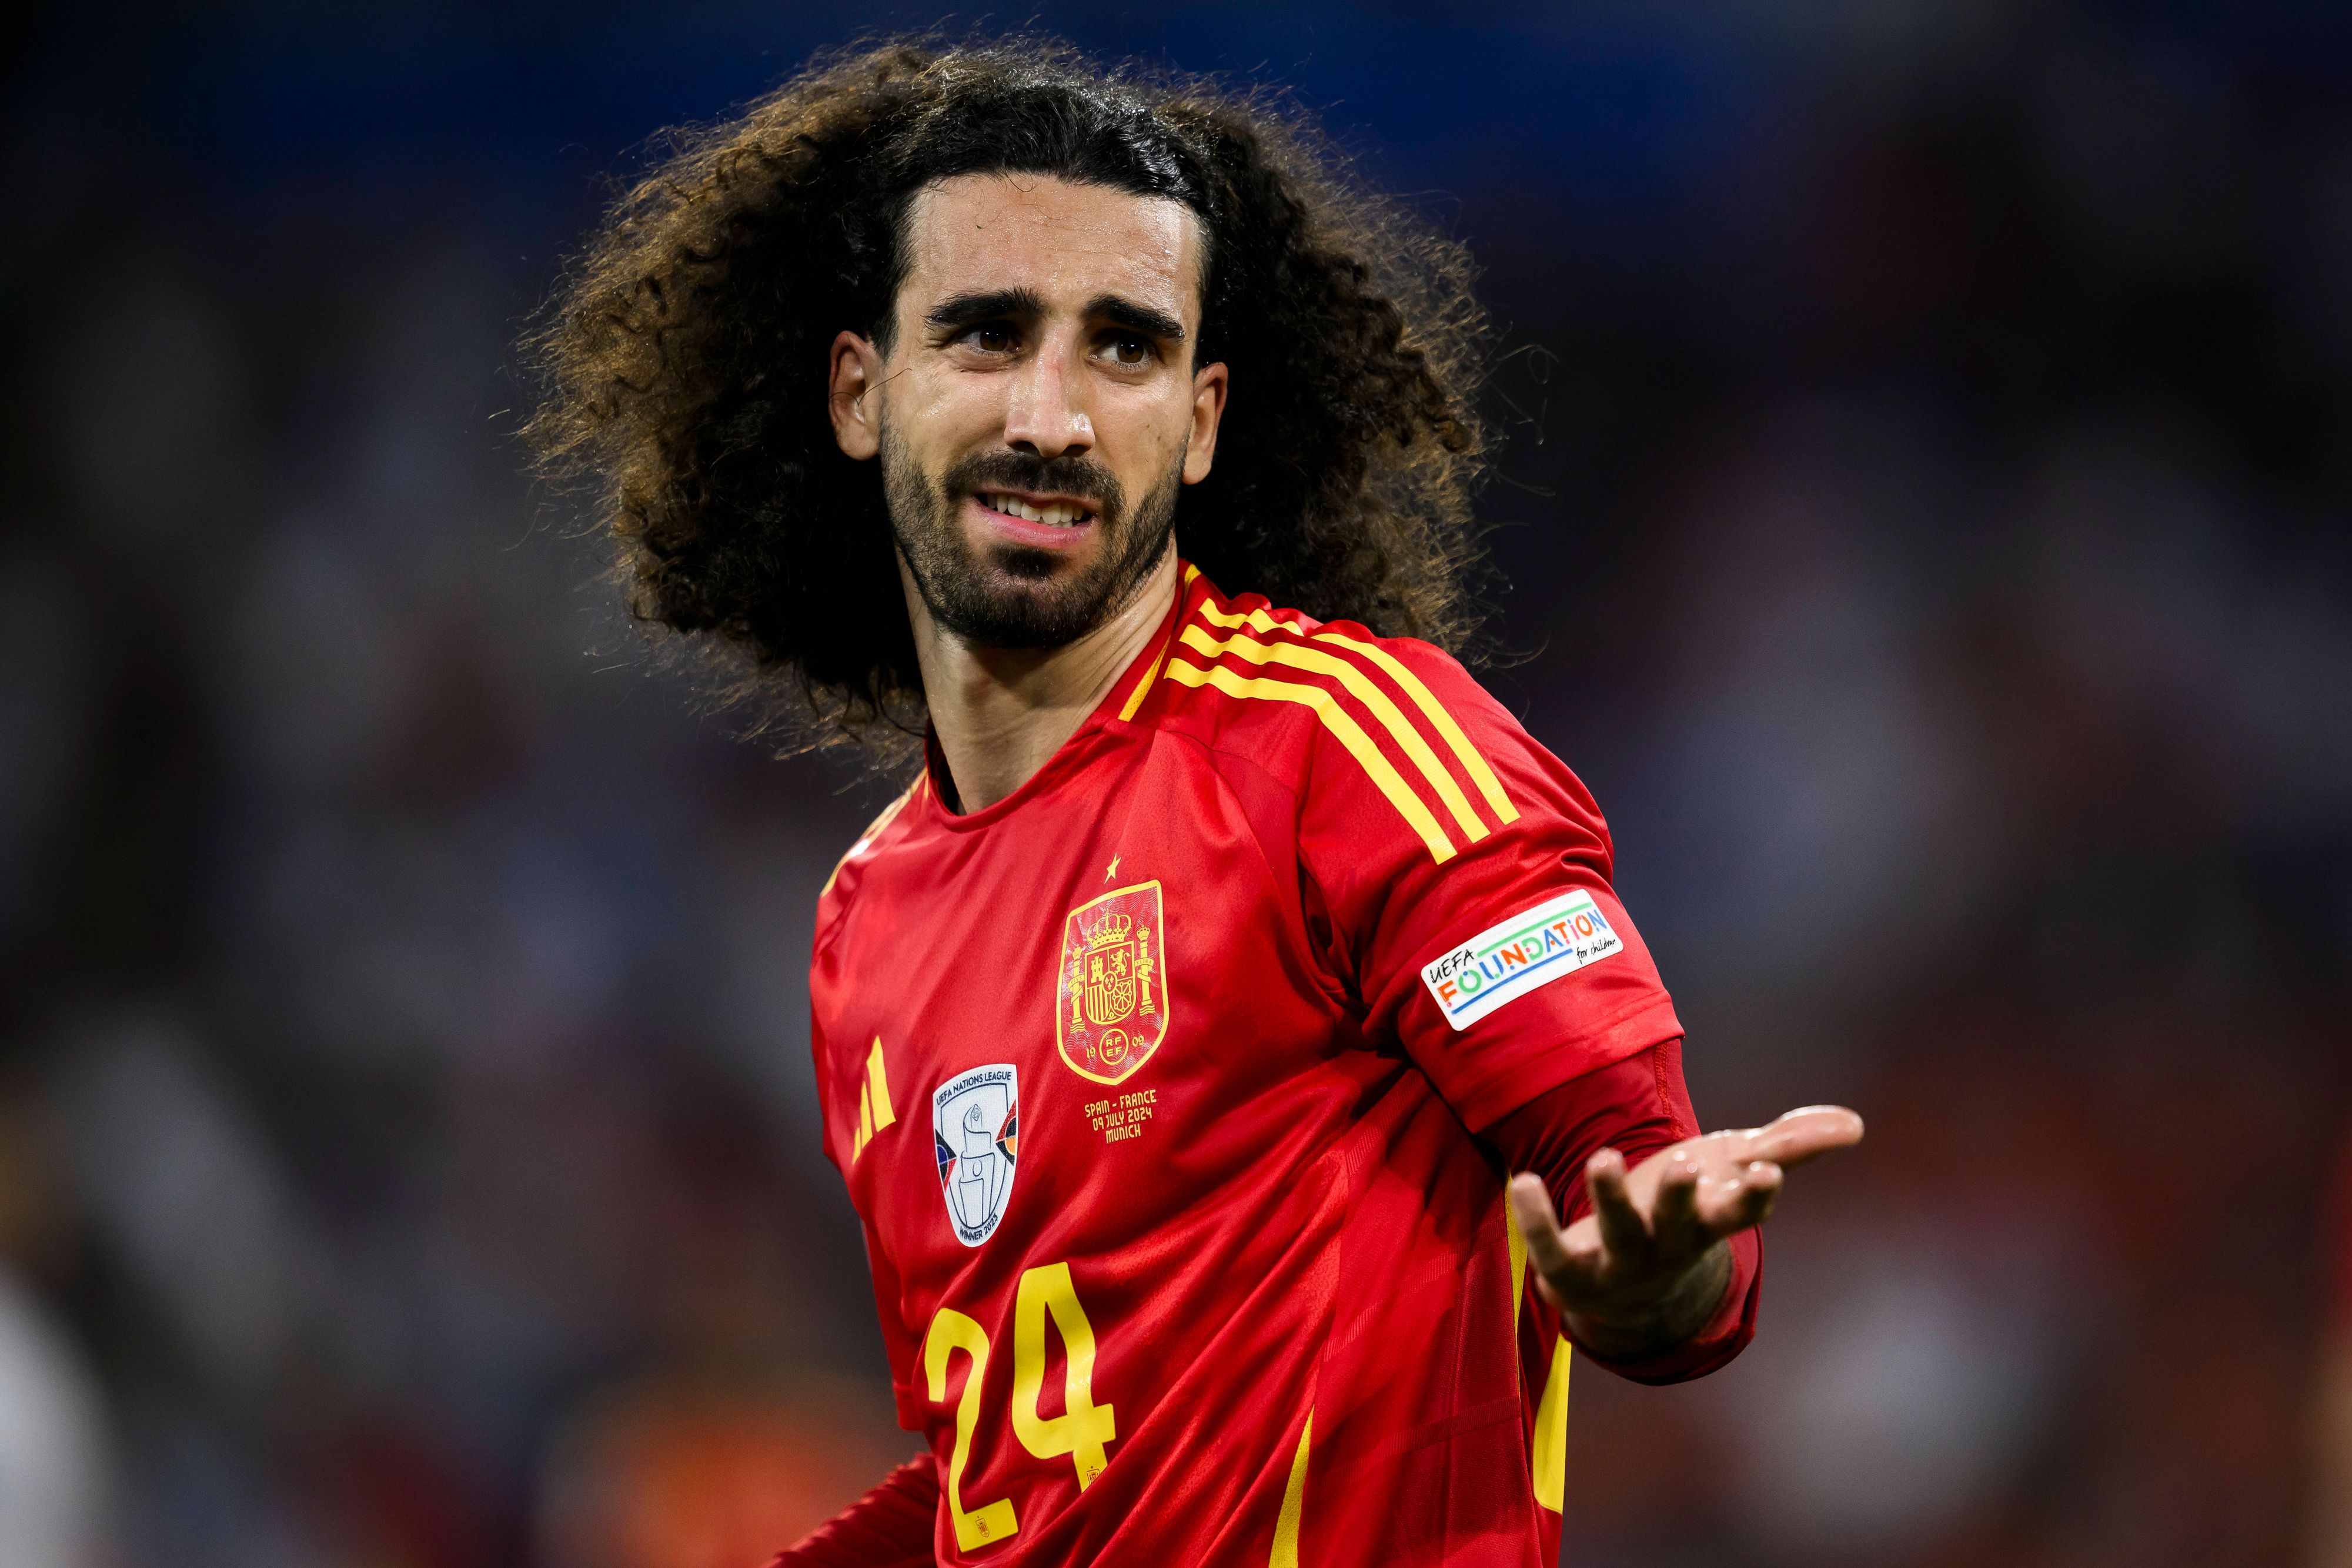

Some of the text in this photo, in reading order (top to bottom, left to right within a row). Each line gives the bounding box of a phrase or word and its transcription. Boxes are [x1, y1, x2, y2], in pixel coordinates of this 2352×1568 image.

[1429, 948, 1474, 984] UEFA
[1437, 908, 1608, 1008] FOUNDATION
[1577, 947, 1587, 965] for
[1086, 1047, 1096, 1058] 19
[1132, 1035, 1144, 1047] 09
[936, 1071, 1012, 1105] UEFA NATIONS LEAGUE
[1084, 1099, 1110, 1118] SPAIN
[1119, 1089, 1157, 1109] FRANCE
[1093, 1106, 1152, 1131] 09 JULY 2024
[1105, 1123, 1141, 1144] MUNICH
[960, 1213, 998, 1241] WINNER 2023
[924, 1261, 1116, 1553] 24
